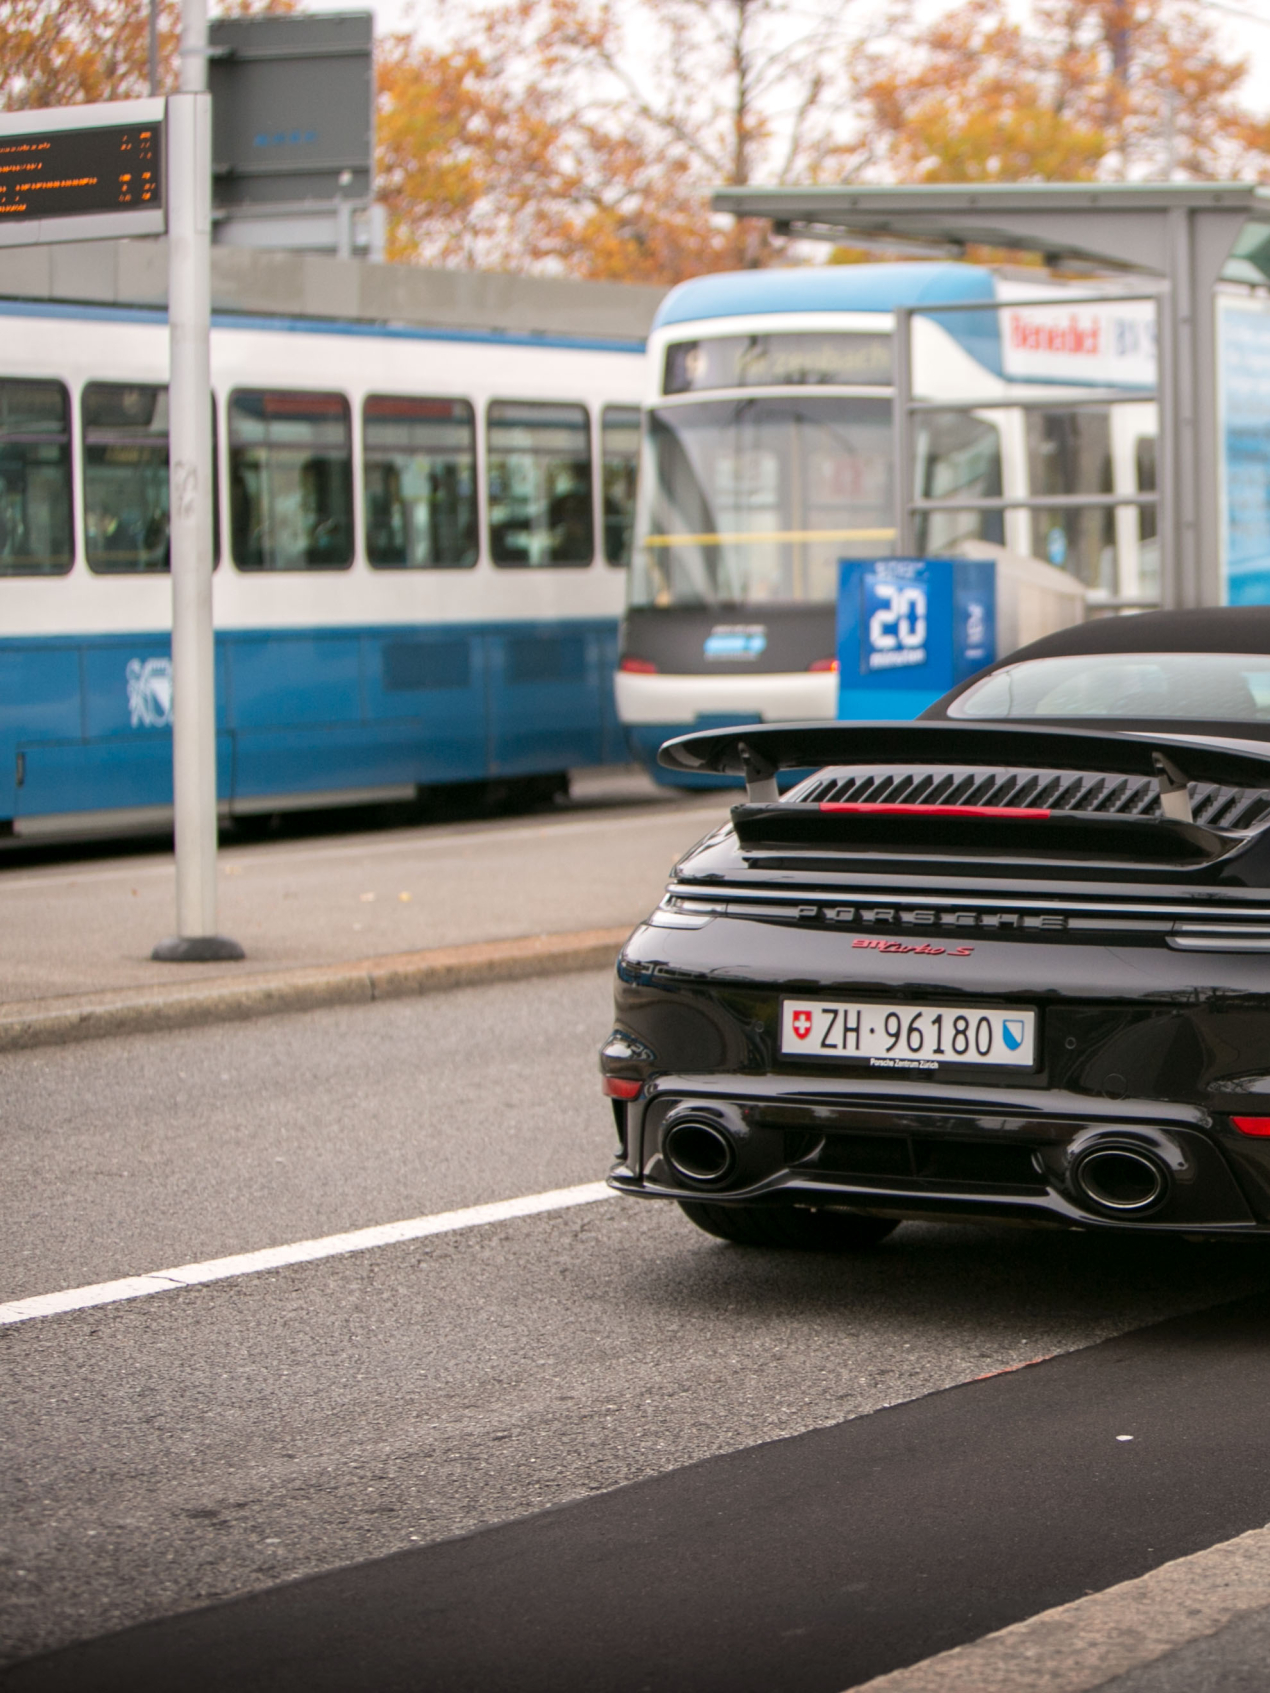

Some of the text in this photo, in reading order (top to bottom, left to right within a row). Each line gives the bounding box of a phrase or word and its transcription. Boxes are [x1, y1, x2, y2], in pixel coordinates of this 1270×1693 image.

[870, 584, 927, 650] 20
[869, 648, 927, 670] minuten
[797, 905, 1068, 930] PORSCHE
[946, 946, 974, 956] S
[869, 1057, 939, 1069] Porsche Zentrum Zürich
